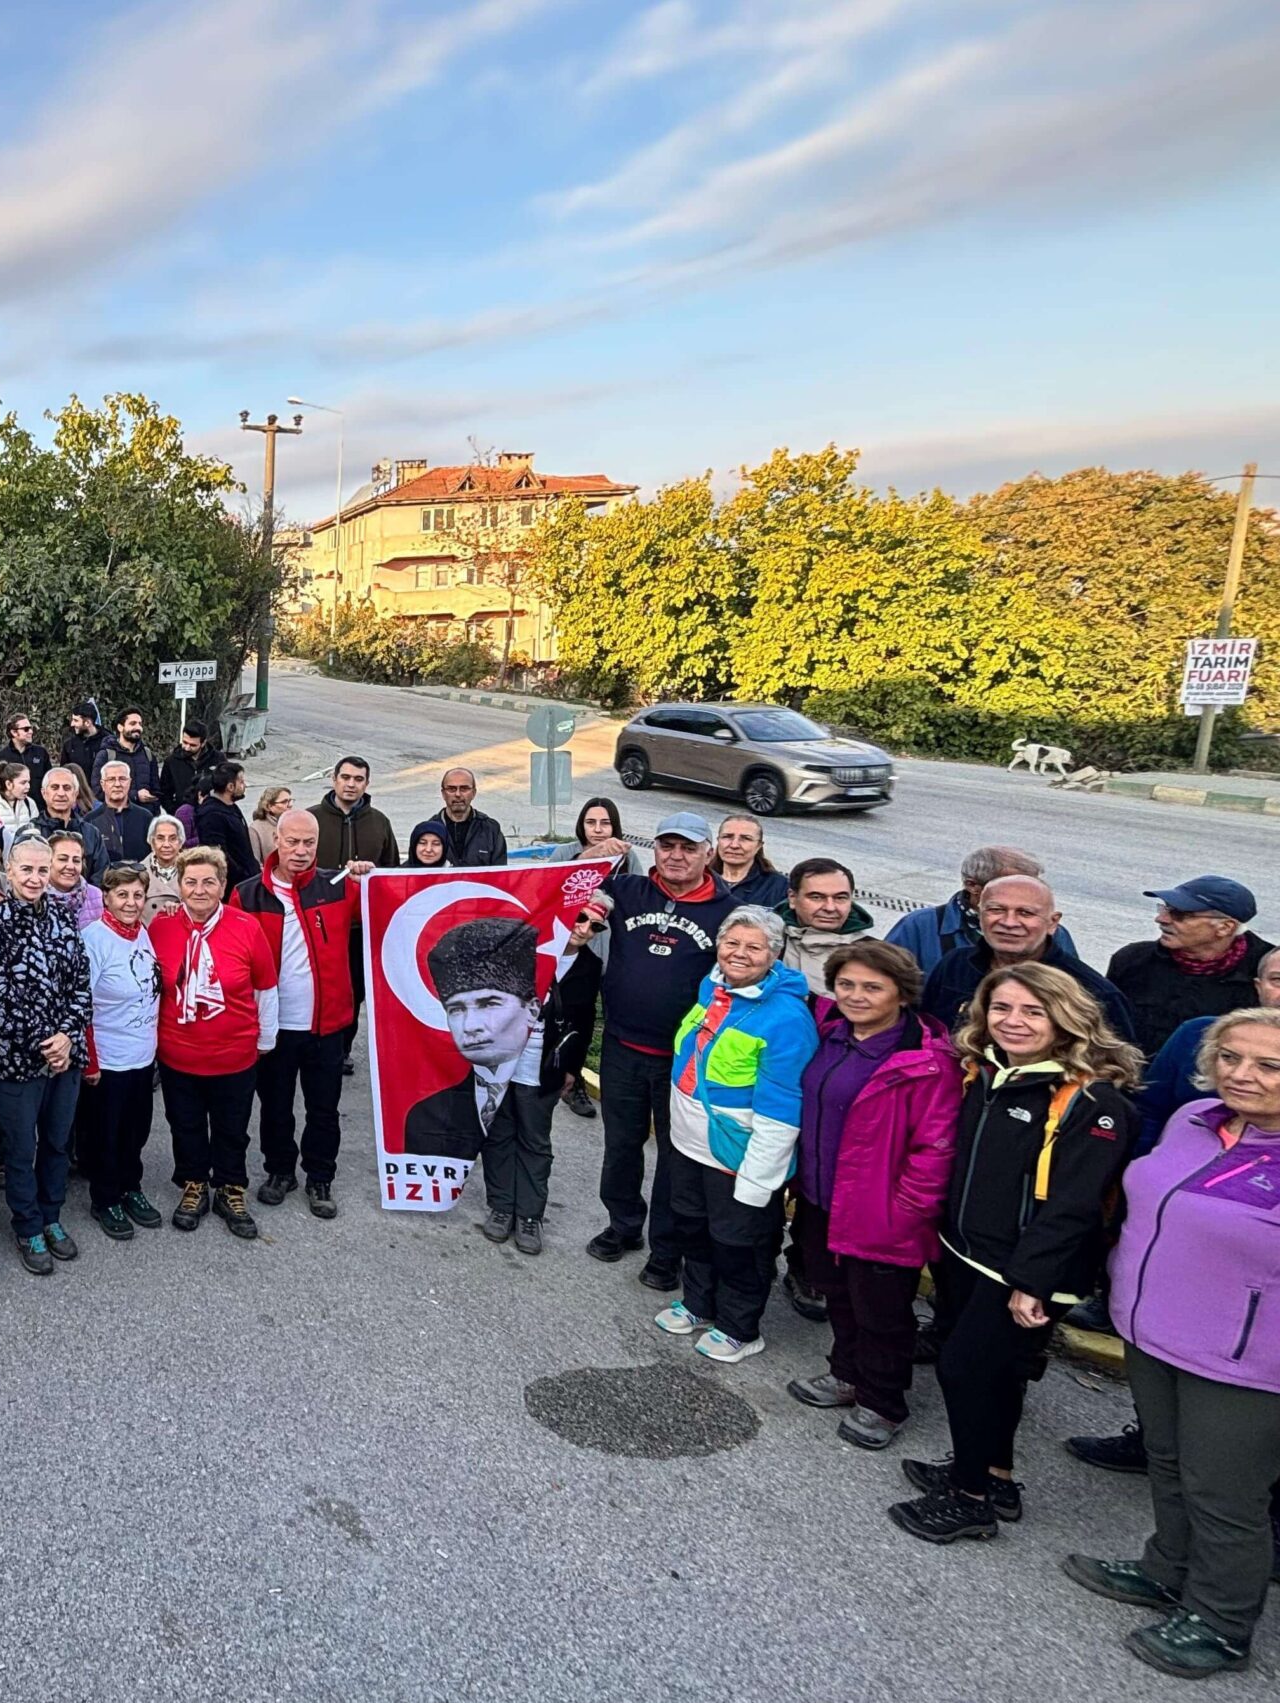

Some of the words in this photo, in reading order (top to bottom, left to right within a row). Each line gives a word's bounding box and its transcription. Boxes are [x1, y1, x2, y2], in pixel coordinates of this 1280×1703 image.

[1191, 641, 1252, 656] İZMİR
[1191, 656, 1251, 669] TARIM
[174, 664, 214, 680] Kayapa
[1187, 670, 1247, 683] FUARI
